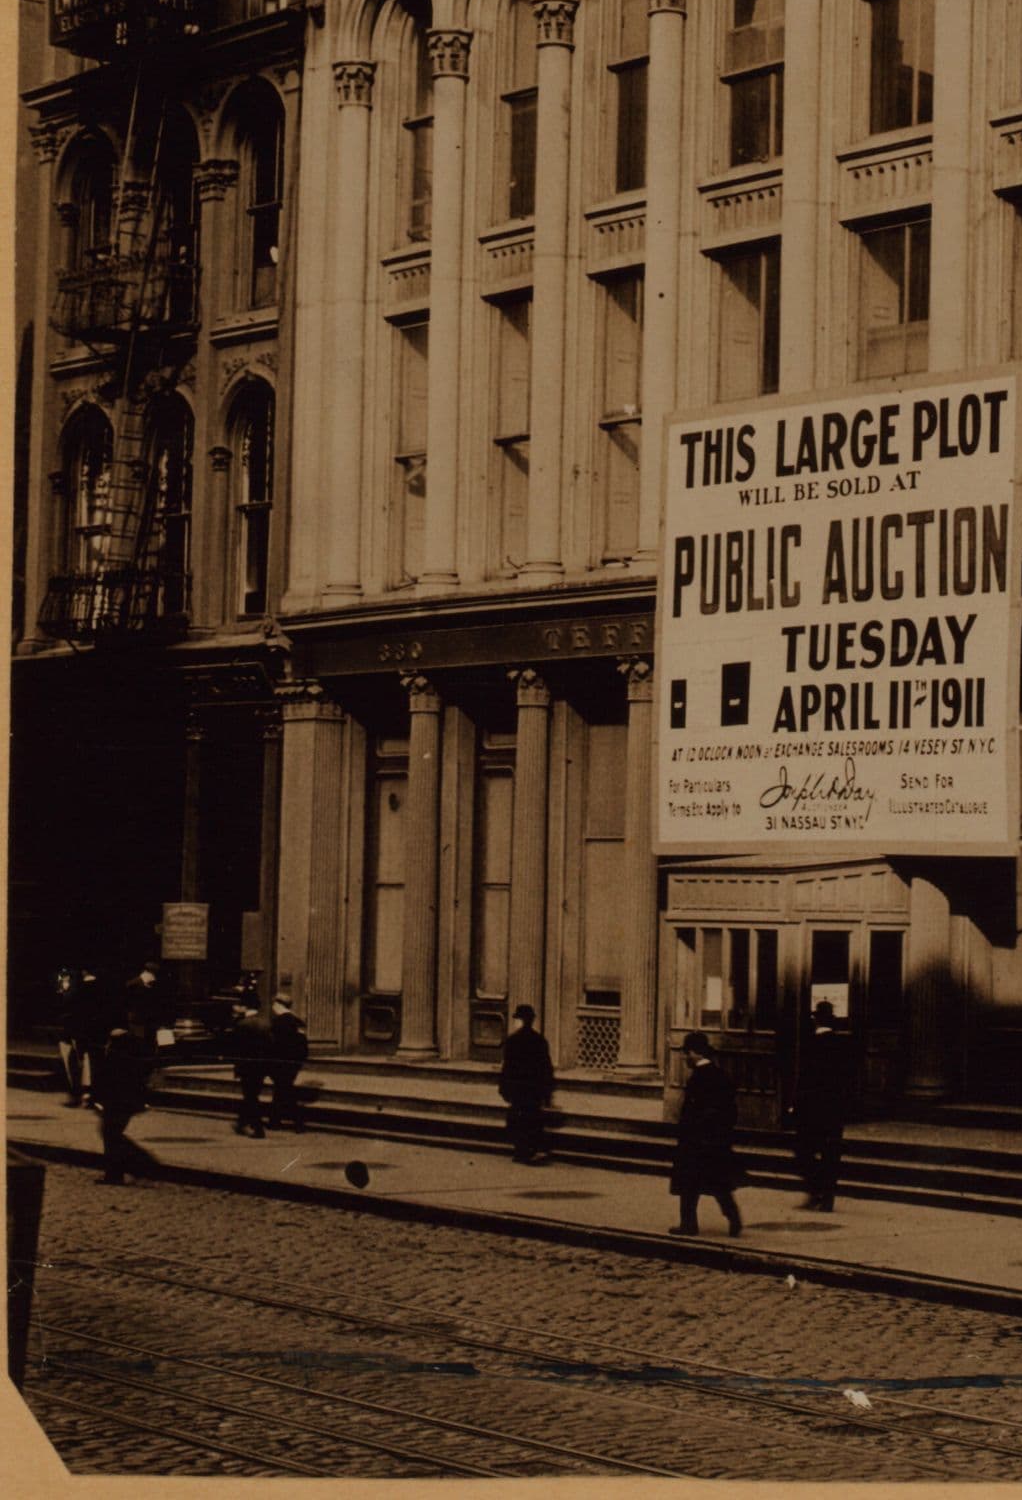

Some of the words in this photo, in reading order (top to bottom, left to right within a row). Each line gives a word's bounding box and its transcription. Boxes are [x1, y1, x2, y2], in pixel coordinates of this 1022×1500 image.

[680, 424, 756, 489] THIS
[775, 403, 900, 477] LARGE
[912, 389, 1008, 462] PLOT
[738, 485, 786, 507] WILL
[793, 481, 819, 501] BE
[826, 475, 880, 499] SOLD
[889, 470, 921, 492] AT
[672, 523, 802, 618] PUBLIC
[822, 503, 1009, 605] AUCTION
[781, 613, 978, 673] TUESDAY
[771, 682, 880, 733] APRIL
[930, 676, 985, 729] 1911
[774, 740, 825, 759] EXCHANGE
[828, 739, 894, 757] SALESROOMS
[914, 738, 947, 755] VESEY
[764, 815, 777, 830] 31
[781, 815, 826, 830] NASSAU
